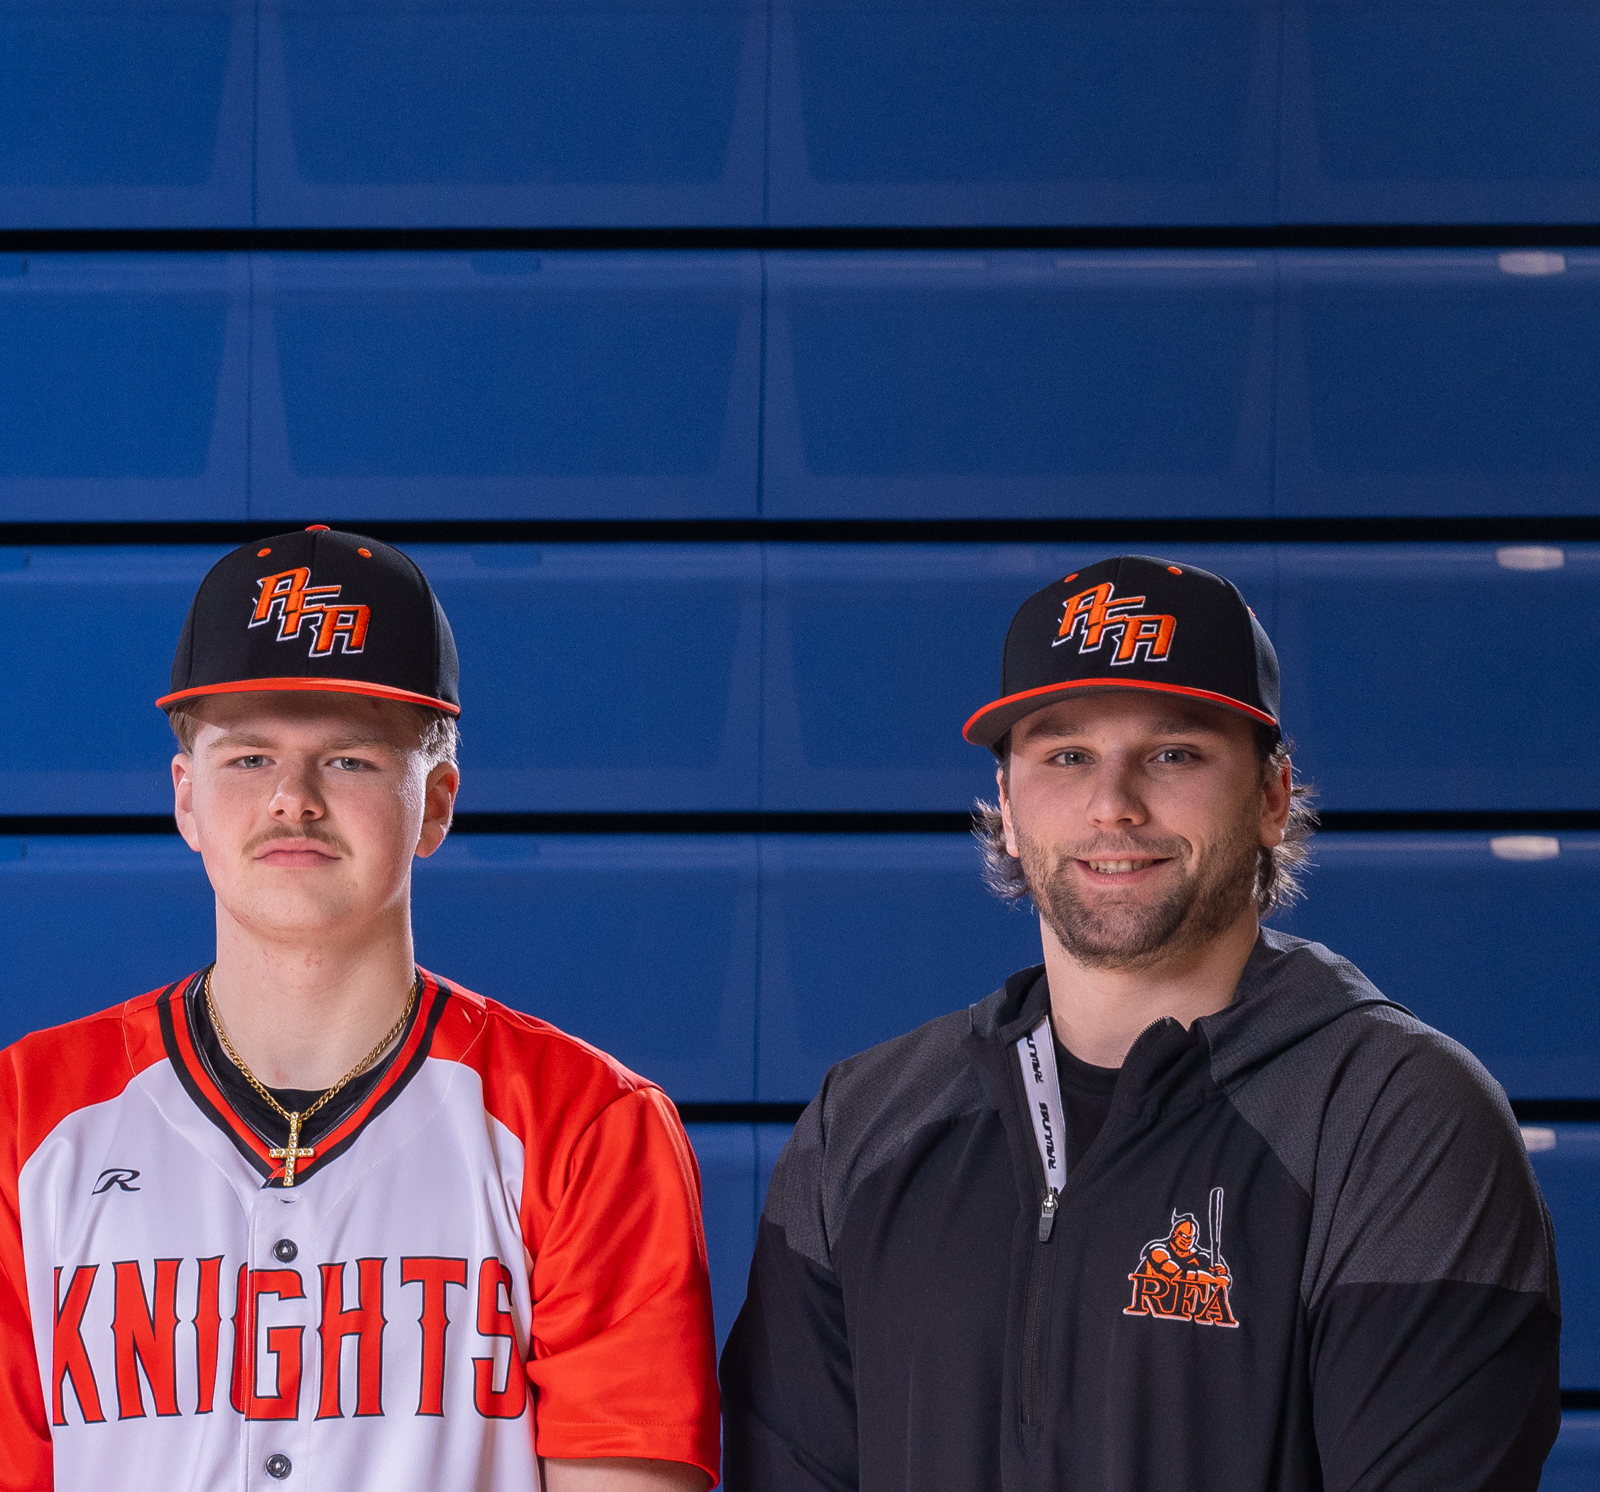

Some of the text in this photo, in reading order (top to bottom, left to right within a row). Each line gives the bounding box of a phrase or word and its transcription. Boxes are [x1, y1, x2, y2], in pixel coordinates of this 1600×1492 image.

[1025, 1030, 1045, 1084] RAWLIN
[1123, 1273, 1239, 1328] RFA
[52, 1255, 528, 1426] KNIGHTS
